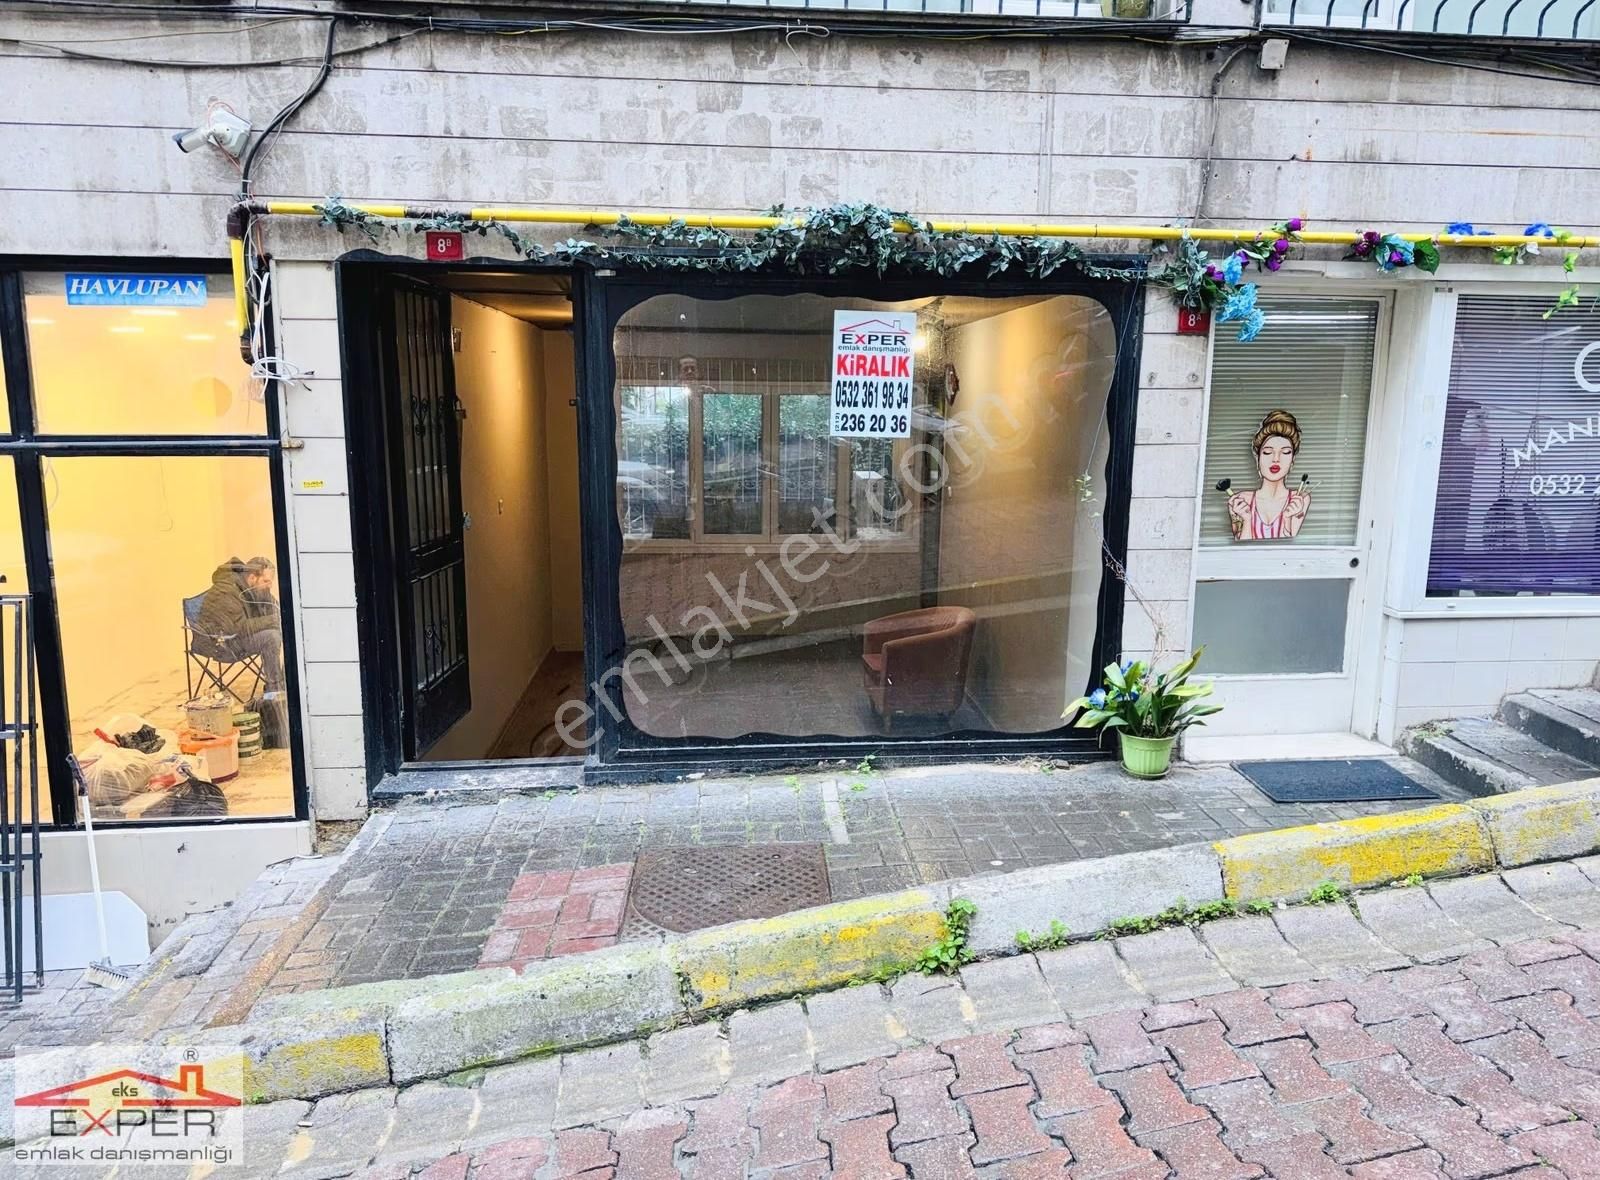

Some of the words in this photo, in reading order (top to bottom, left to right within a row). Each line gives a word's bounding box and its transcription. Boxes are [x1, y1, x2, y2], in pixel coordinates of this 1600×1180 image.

[69, 278, 204, 296] HAVLUPAN
[841, 333, 907, 346] EXPER
[835, 380, 859, 408] 0532
[862, 381, 879, 409] 361
[882, 382, 894, 409] 98
[897, 382, 909, 409] 34
[841, 413, 865, 432] 236
[869, 414, 887, 433] 20
[890, 415, 907, 433] 36
[1529, 474, 1585, 495] 0532
